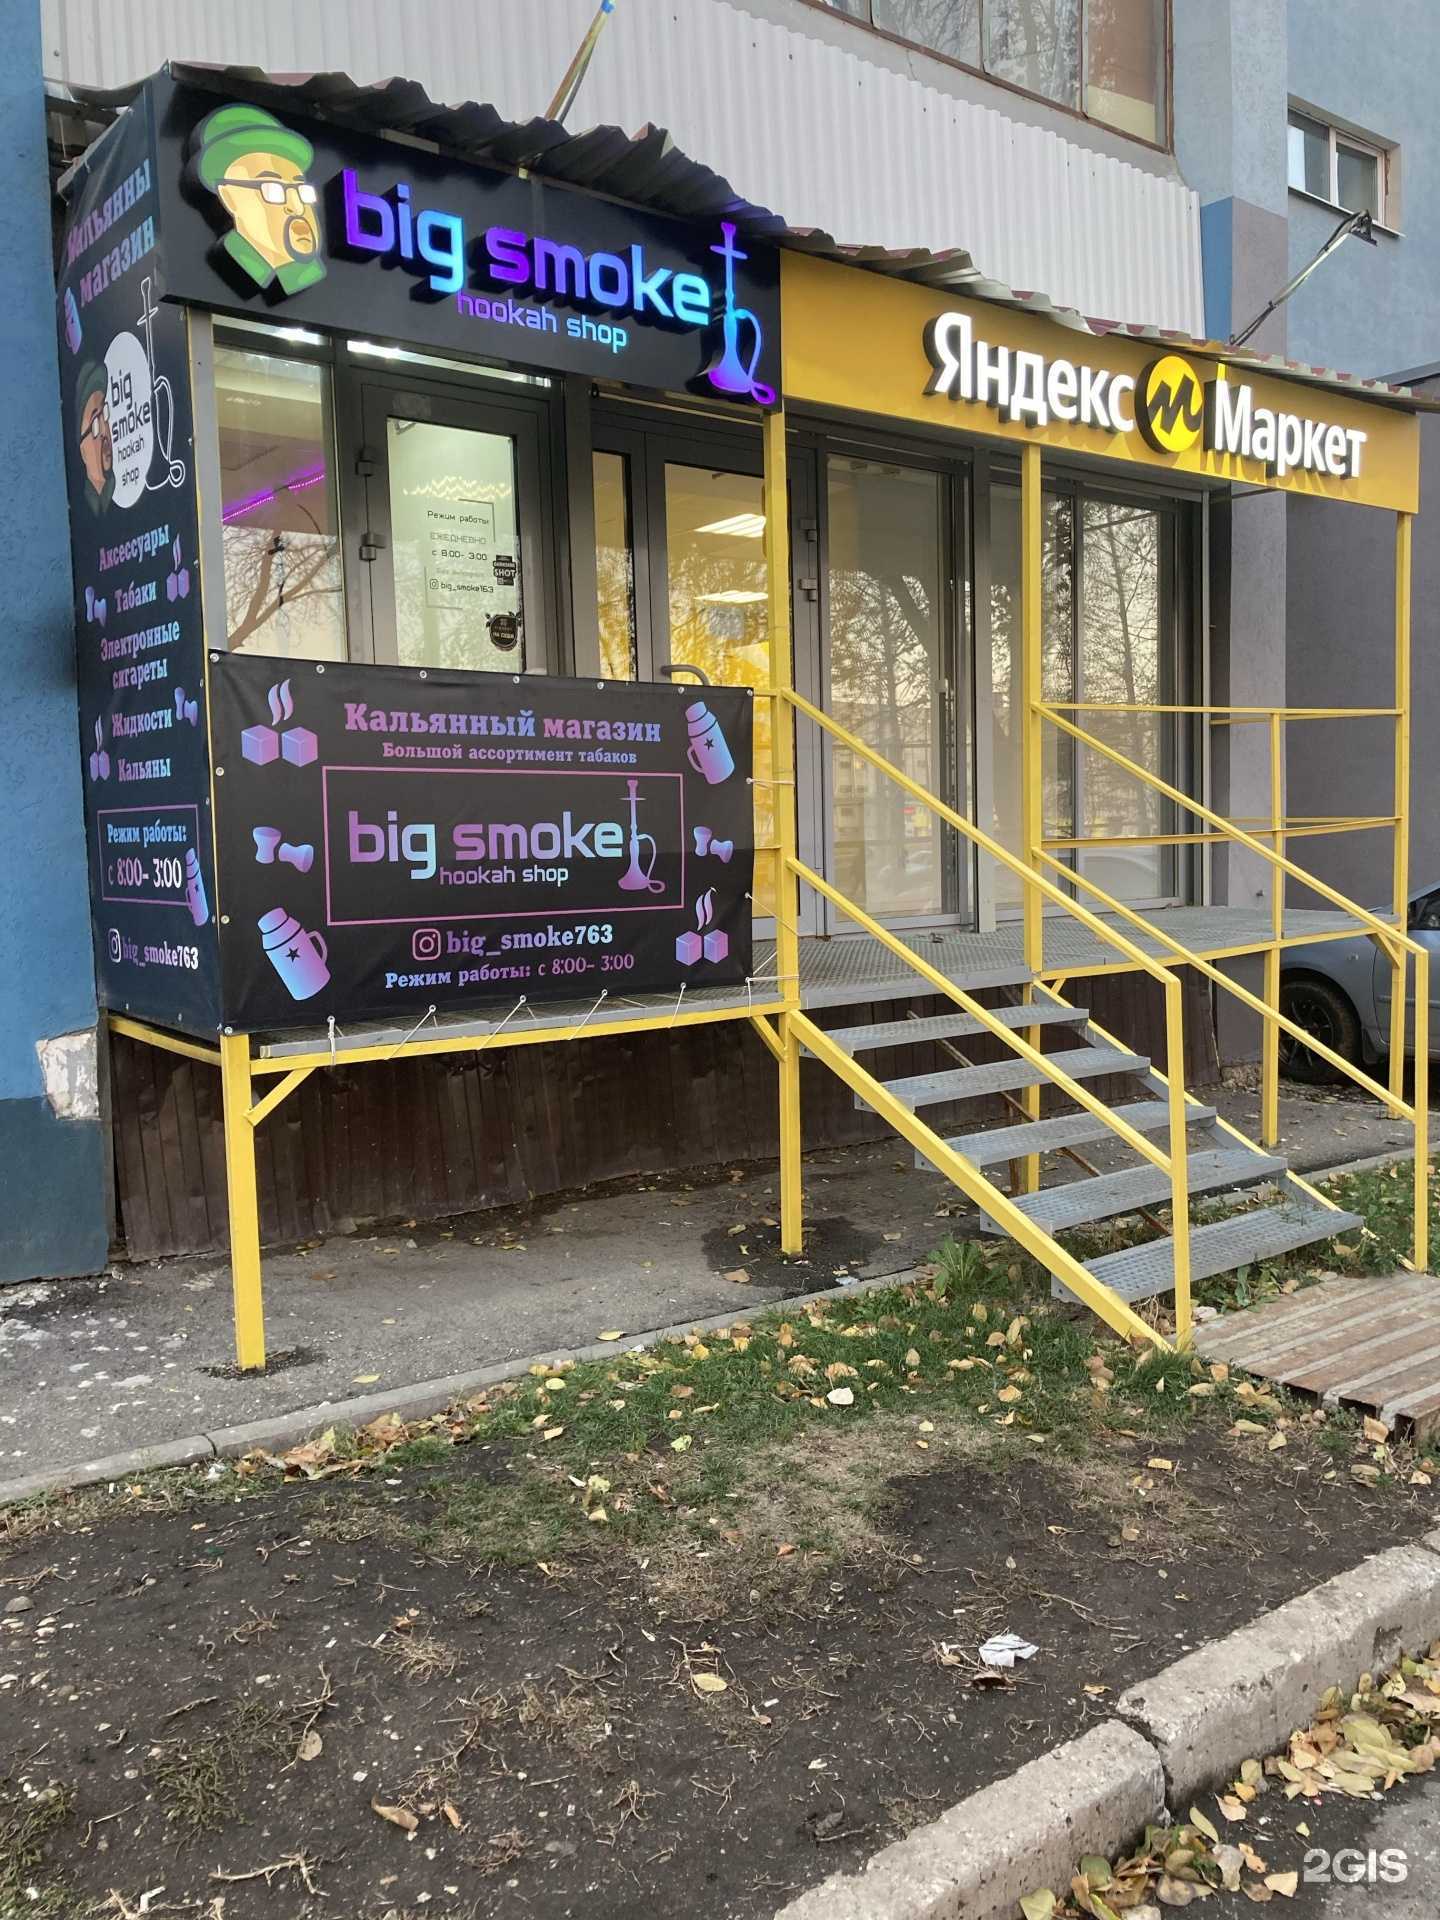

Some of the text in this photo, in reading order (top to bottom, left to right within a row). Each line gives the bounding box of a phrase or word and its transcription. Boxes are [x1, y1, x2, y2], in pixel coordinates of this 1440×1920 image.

[80, 216, 155, 307] магазин
[342, 167, 712, 326] big smoke
[456, 292, 628, 354] hookah shop
[111, 369, 133, 410] big
[932, 311, 1135, 433] Яндекс
[1214, 379, 1368, 478] Маркет
[112, 401, 151, 443] smoke
[118, 436, 145, 461] hookah
[122, 466, 140, 486] shop
[427, 510, 456, 522] Режим
[99, 524, 170, 572] Аксессуары
[494, 568, 516, 577] SHOT
[114, 581, 157, 613] Табаки
[100, 621, 180, 662] Электронные
[112, 658, 168, 690] сигареты
[112, 708, 173, 738] Жидкости
[344, 702, 662, 743] Кальянный магазин
[382, 742, 638, 764] Большой ассортимент табаков
[118, 758, 171, 782] Кальяны
[107, 818, 187, 848] Режим работы:
[348, 810, 624, 880] big smoke
[439, 864, 569, 887] hookah shop
[122, 936, 199, 970] big_smoke763
[446, 924, 613, 957] big_smoke763
[385, 972, 452, 989] Режим
[458, 964, 531, 987] работы:
[538, 963, 546, 976] с
[600, 954, 635, 972] 3:00
